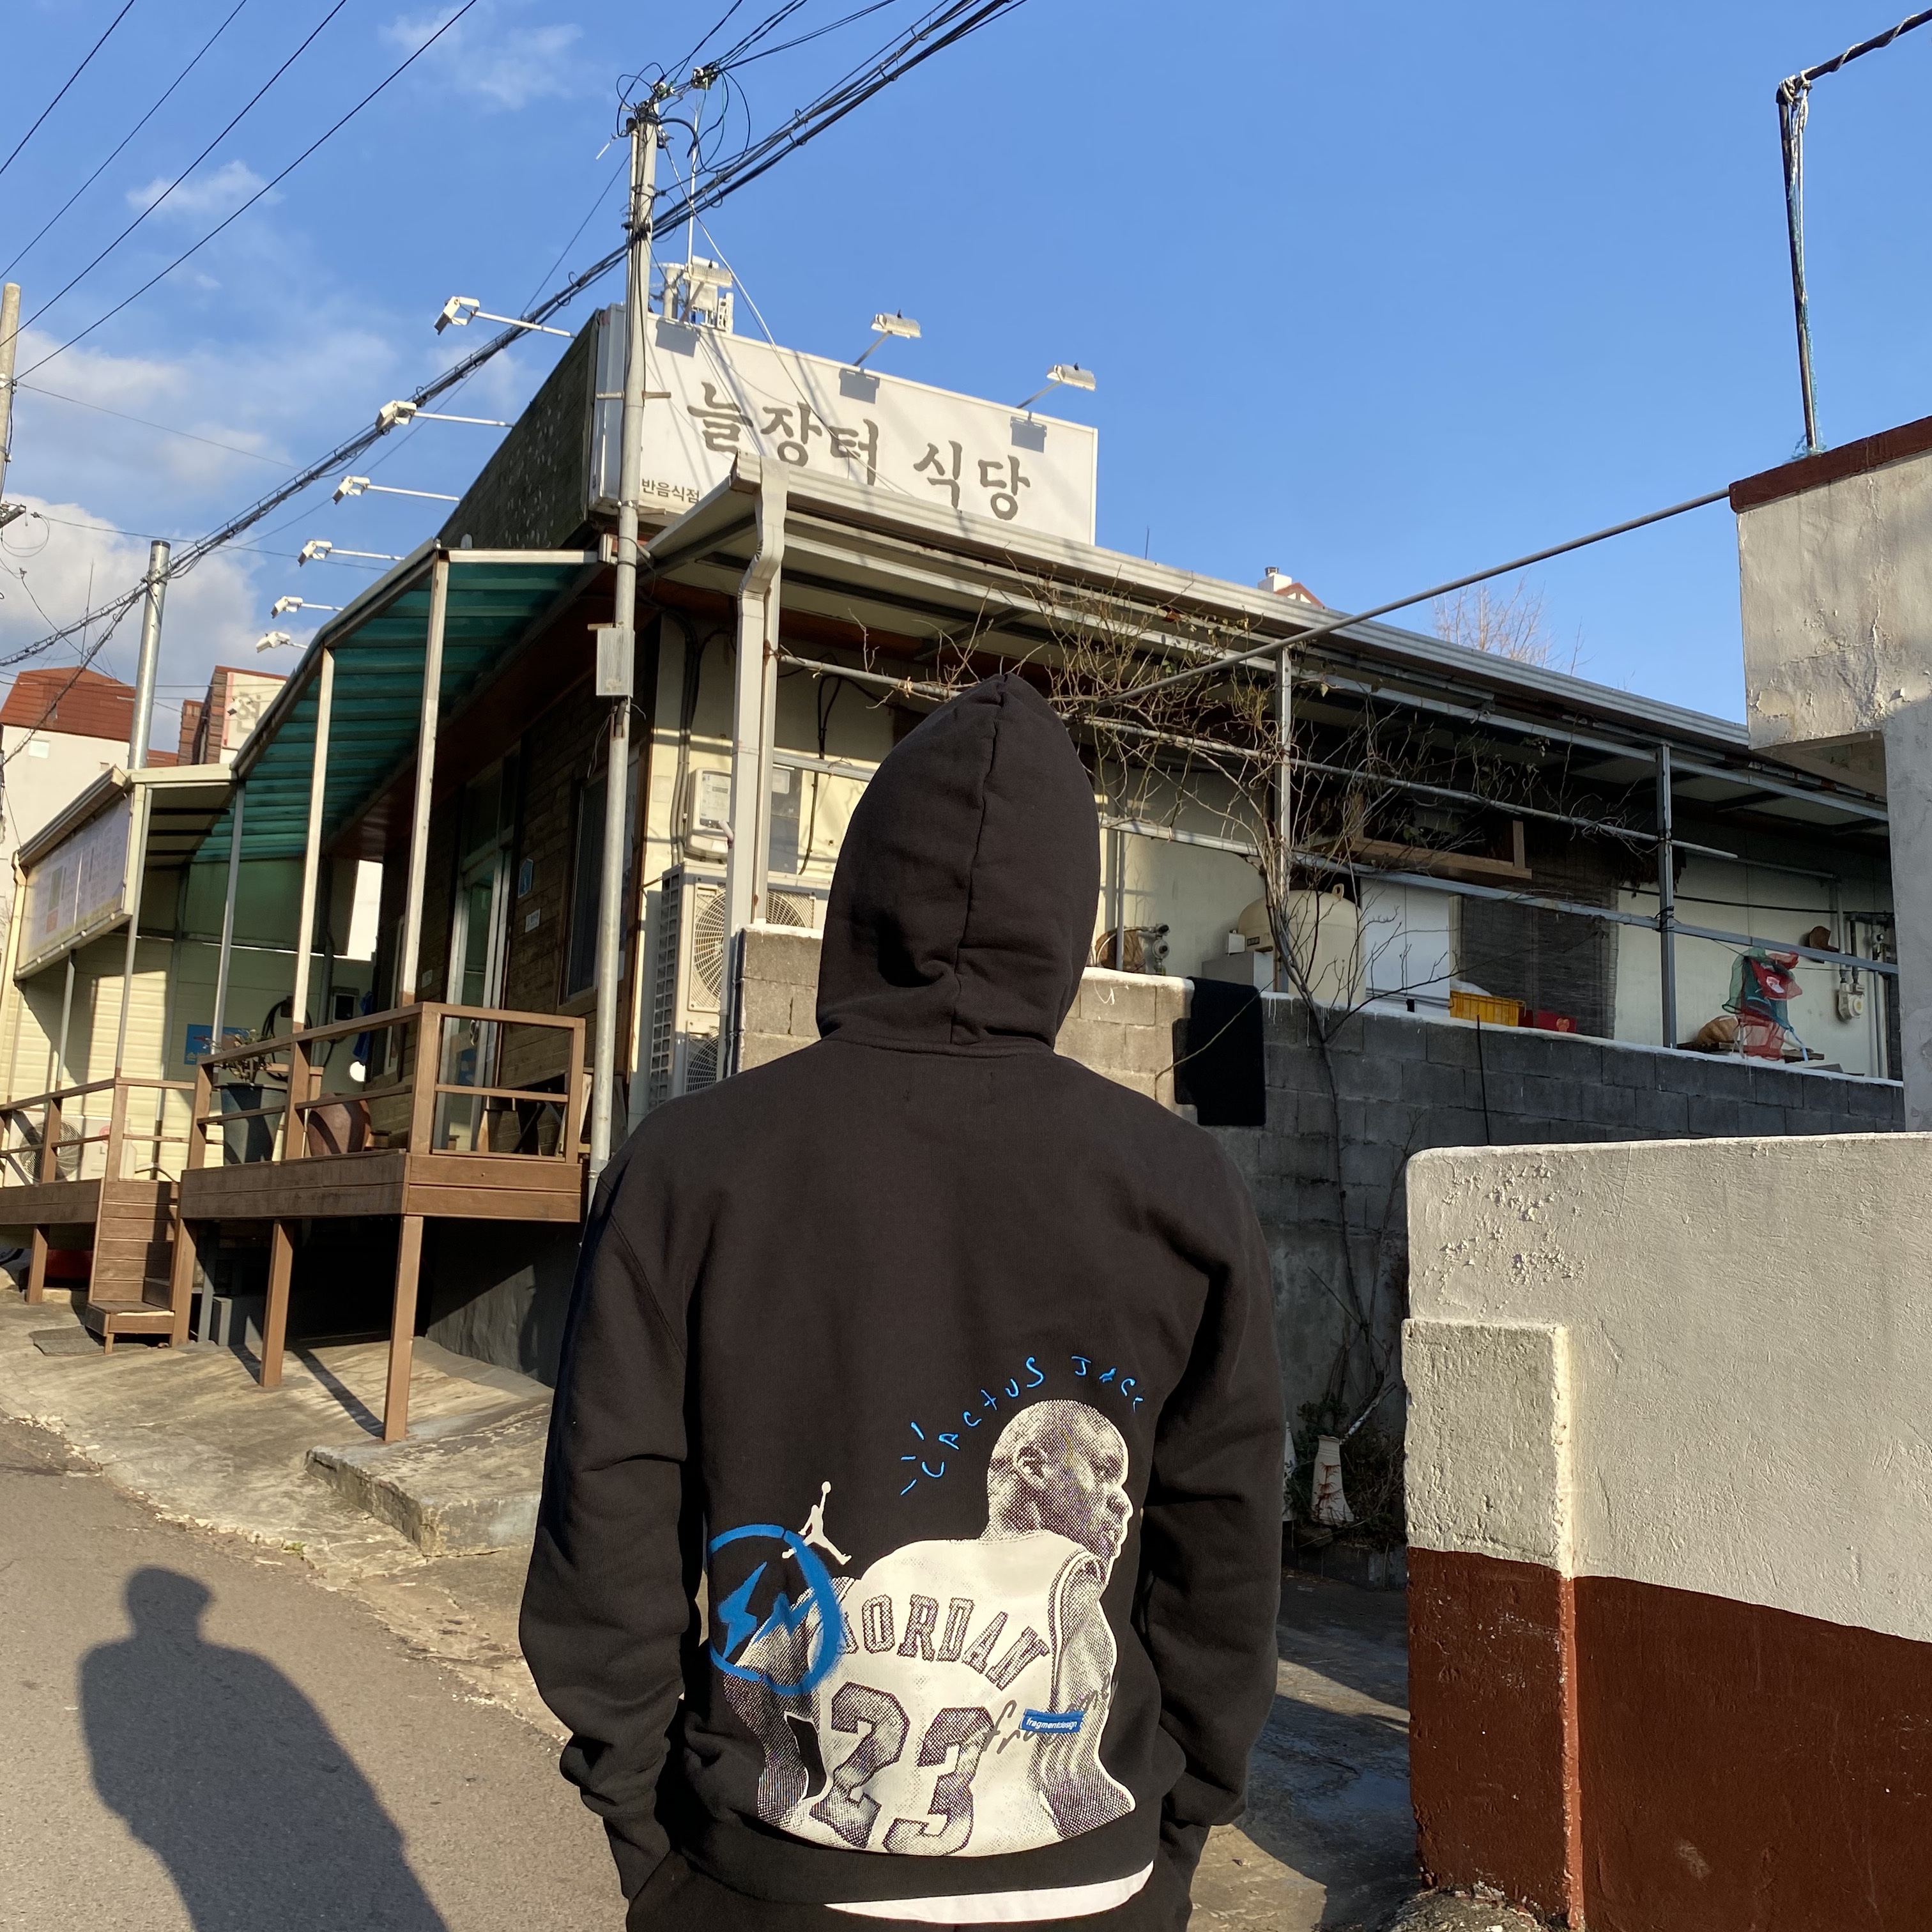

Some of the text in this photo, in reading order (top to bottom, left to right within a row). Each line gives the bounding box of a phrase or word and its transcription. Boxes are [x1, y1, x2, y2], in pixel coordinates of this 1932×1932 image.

[640, 478, 700, 504] 반음식점
[687, 381, 1031, 520] 늘장터 식당
[809, 1681, 995, 1856] 23
